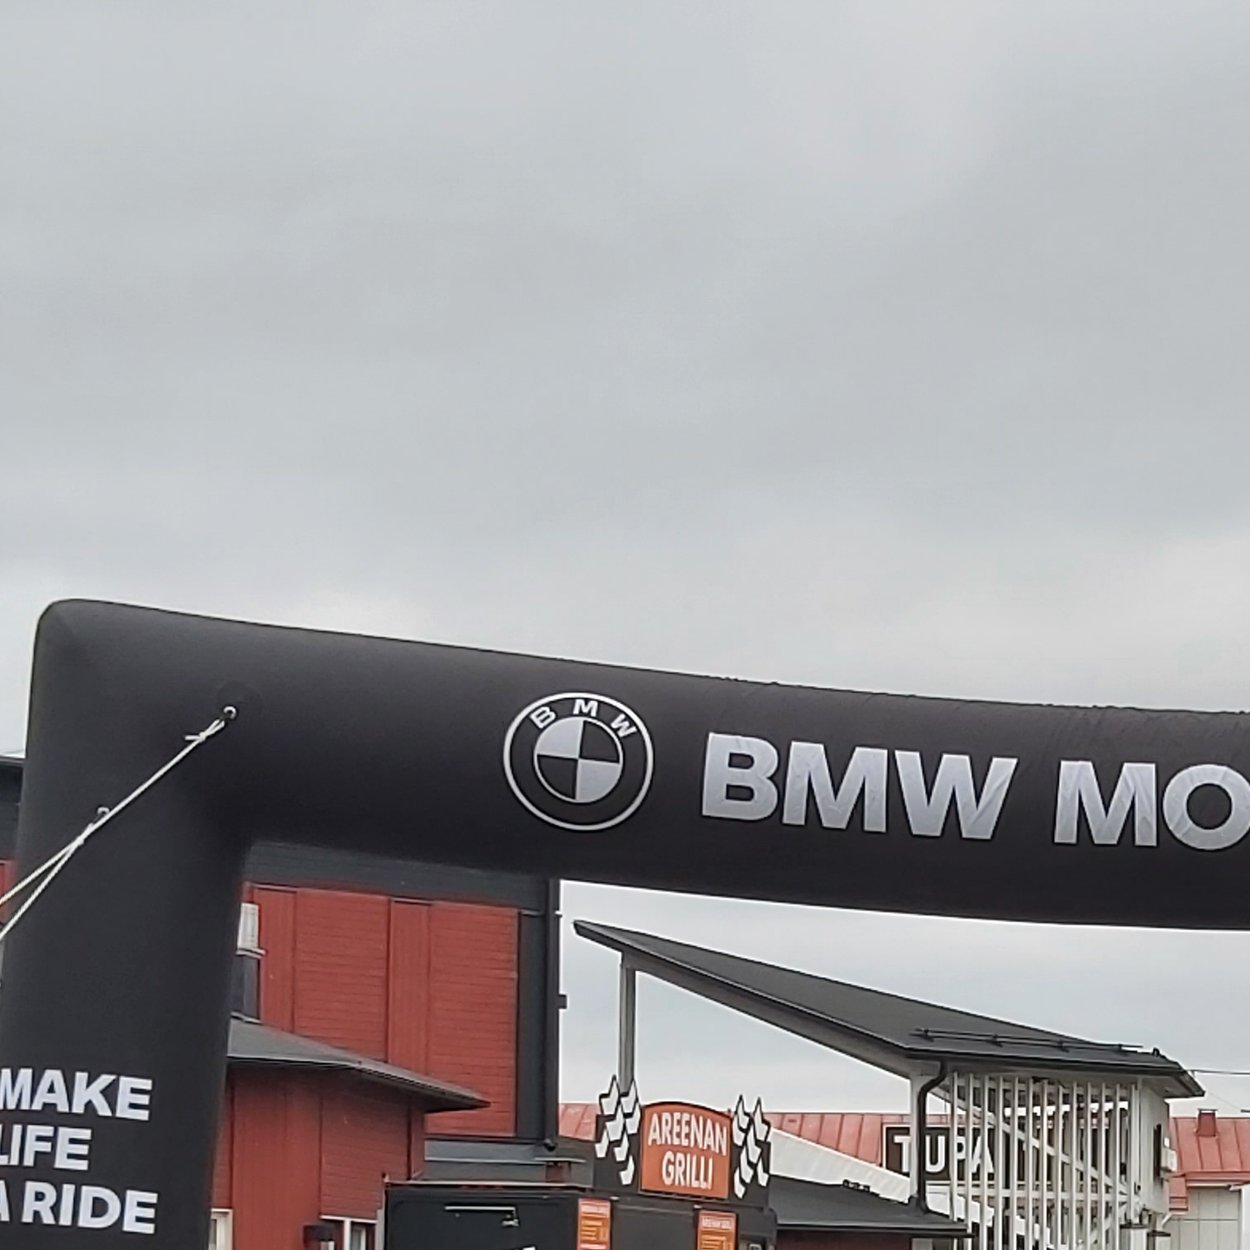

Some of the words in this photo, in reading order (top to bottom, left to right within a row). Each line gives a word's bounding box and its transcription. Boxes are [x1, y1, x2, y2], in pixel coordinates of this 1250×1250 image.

[529, 698, 638, 739] BMW
[701, 731, 1018, 840] BMW
[0, 1068, 153, 1121] MAKE
[647, 1112, 727, 1157] AREENAN
[662, 1150, 713, 1190] GRILLI
[21, 1180, 158, 1235] RIDE
